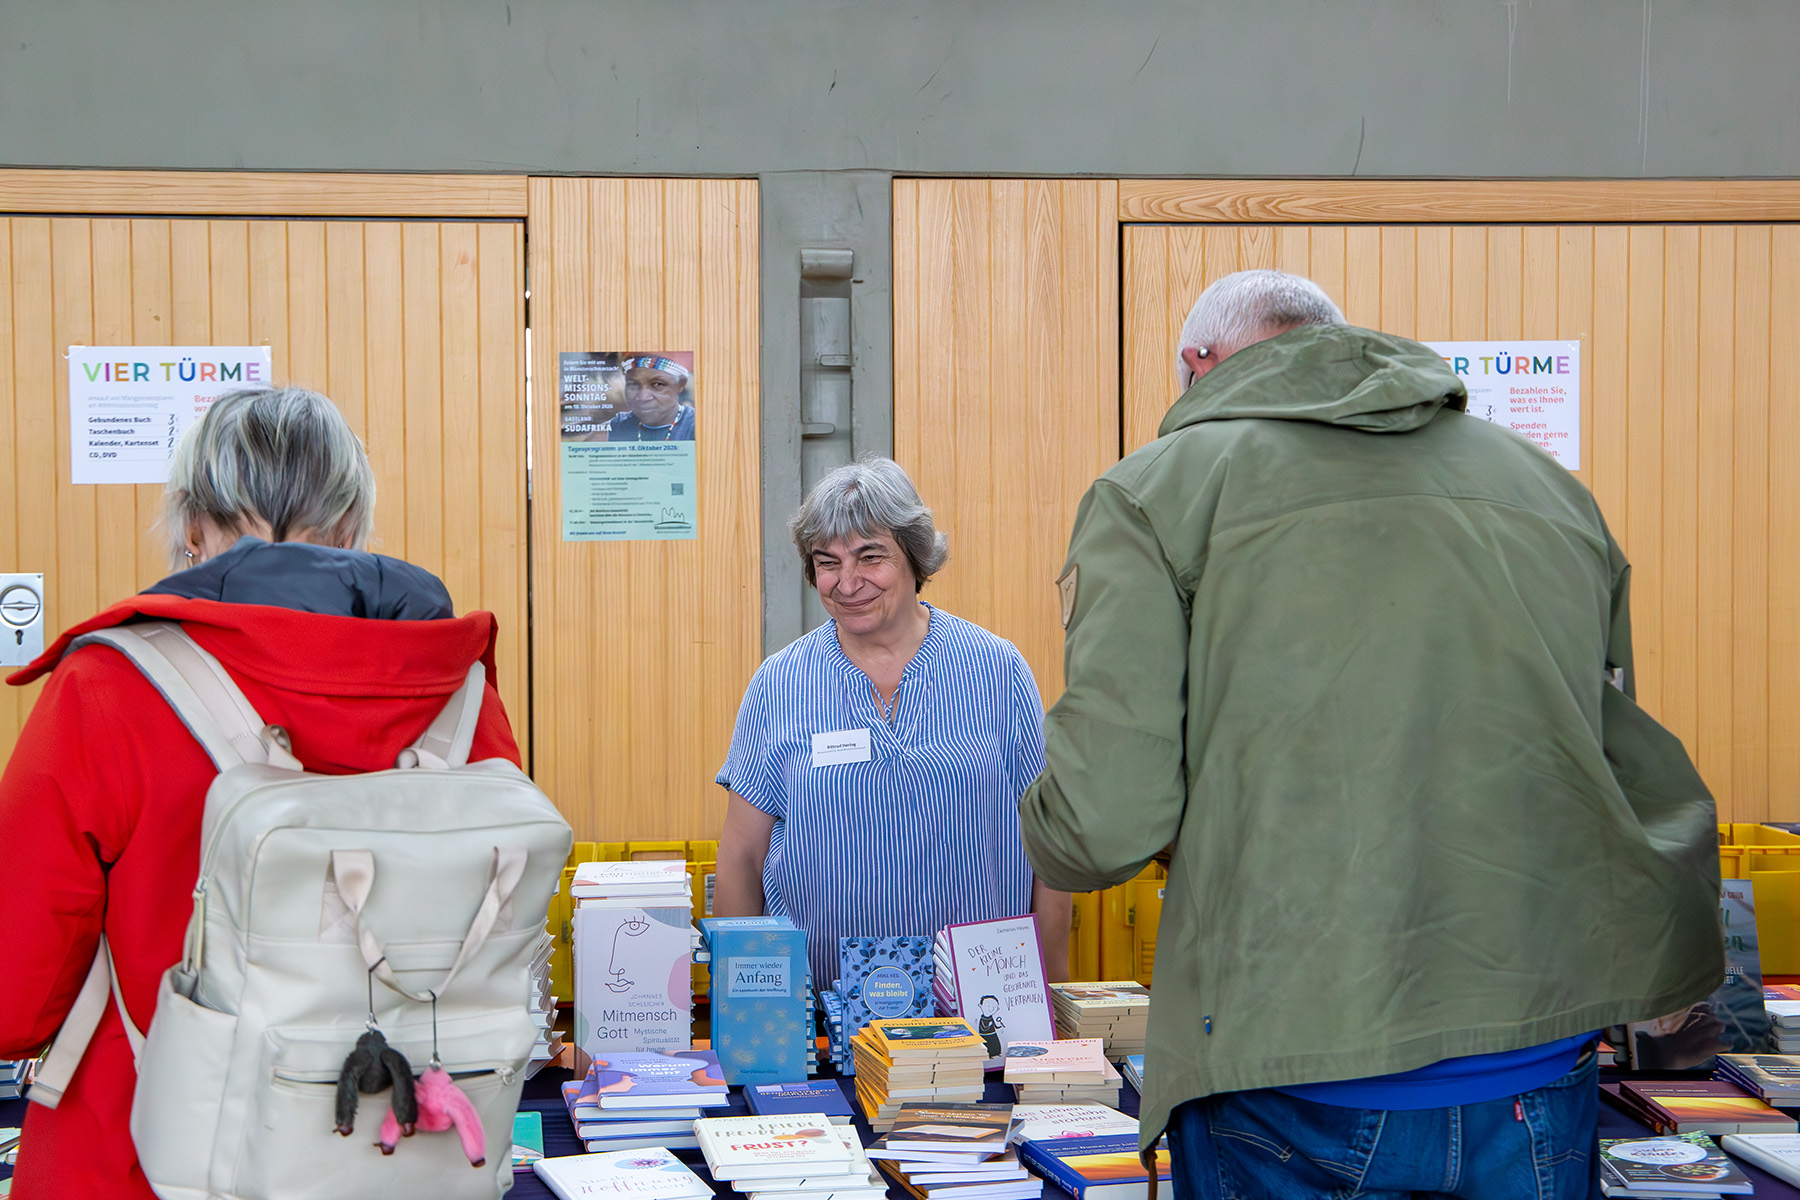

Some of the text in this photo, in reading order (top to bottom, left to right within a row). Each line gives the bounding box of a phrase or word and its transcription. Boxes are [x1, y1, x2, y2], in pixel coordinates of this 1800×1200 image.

[1479, 351, 1570, 375] TÜRME
[82, 357, 261, 382] VIER TÜRME
[564, 375, 589, 383] WELT-
[564, 384, 612, 392] MISSIONS-
[1509, 387, 1567, 396] Bezahlen Sie,
[194, 394, 219, 403] Beza
[564, 393, 607, 402] SONNTAG
[1539, 396, 1564, 404] Ihnen
[1531, 405, 1545, 413] ist.
[564, 423, 612, 432] SÜDAFRIKA
[1510, 421, 1547, 430] Spenden
[1543, 431, 1569, 440] gerne
[967, 944, 988, 959] DER
[979, 946, 1003, 966] KLEINE
[986, 954, 1027, 977] MÖNCH
[1725, 966, 1744, 975] UELLE
[735, 970, 783, 987] Anfang
[1003, 973, 1016, 981] UND
[1003, 981, 1037, 993] GESCHENKTE
[1004, 993, 1044, 1011] VERTRAUEN
[603, 1008, 677, 1023] Mitmensch
[597, 1026, 667, 1040] Gott Mystische
[643, 1036, 680, 1044] Spiritualität
[1039, 1106, 1084, 1115] Leben
[1043, 1113, 1064, 1121] die
[1069, 1109, 1108, 1117] Liebe
[730, 1140, 808, 1151] FRUST?
